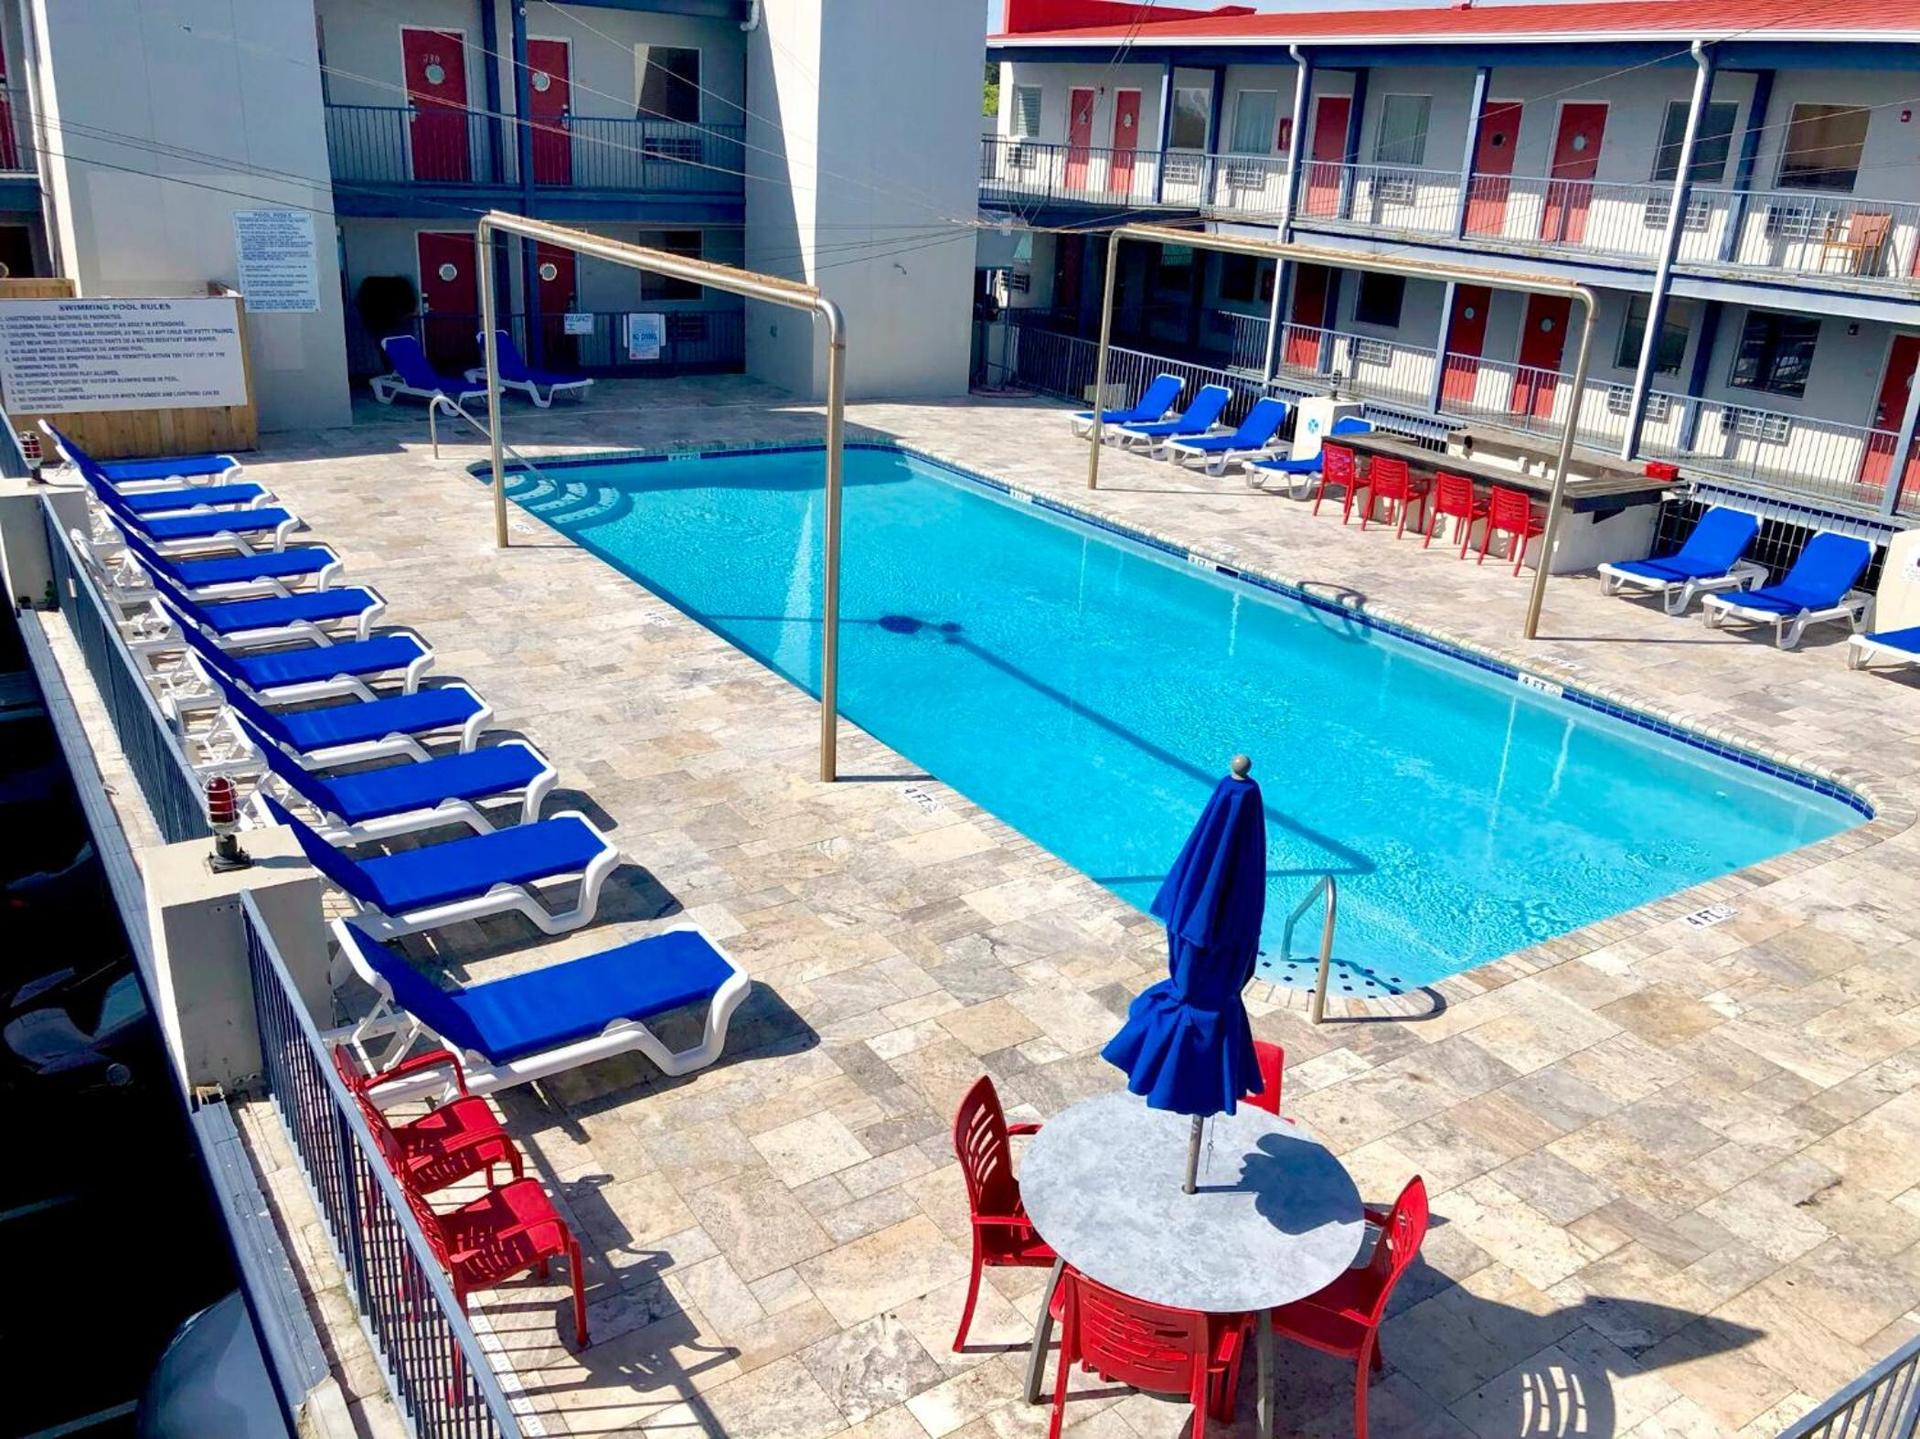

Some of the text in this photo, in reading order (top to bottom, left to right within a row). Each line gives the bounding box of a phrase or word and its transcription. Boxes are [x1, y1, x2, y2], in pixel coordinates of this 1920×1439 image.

[141, 303, 171, 311] RULES
[1686, 910, 1722, 926] 4 FT
